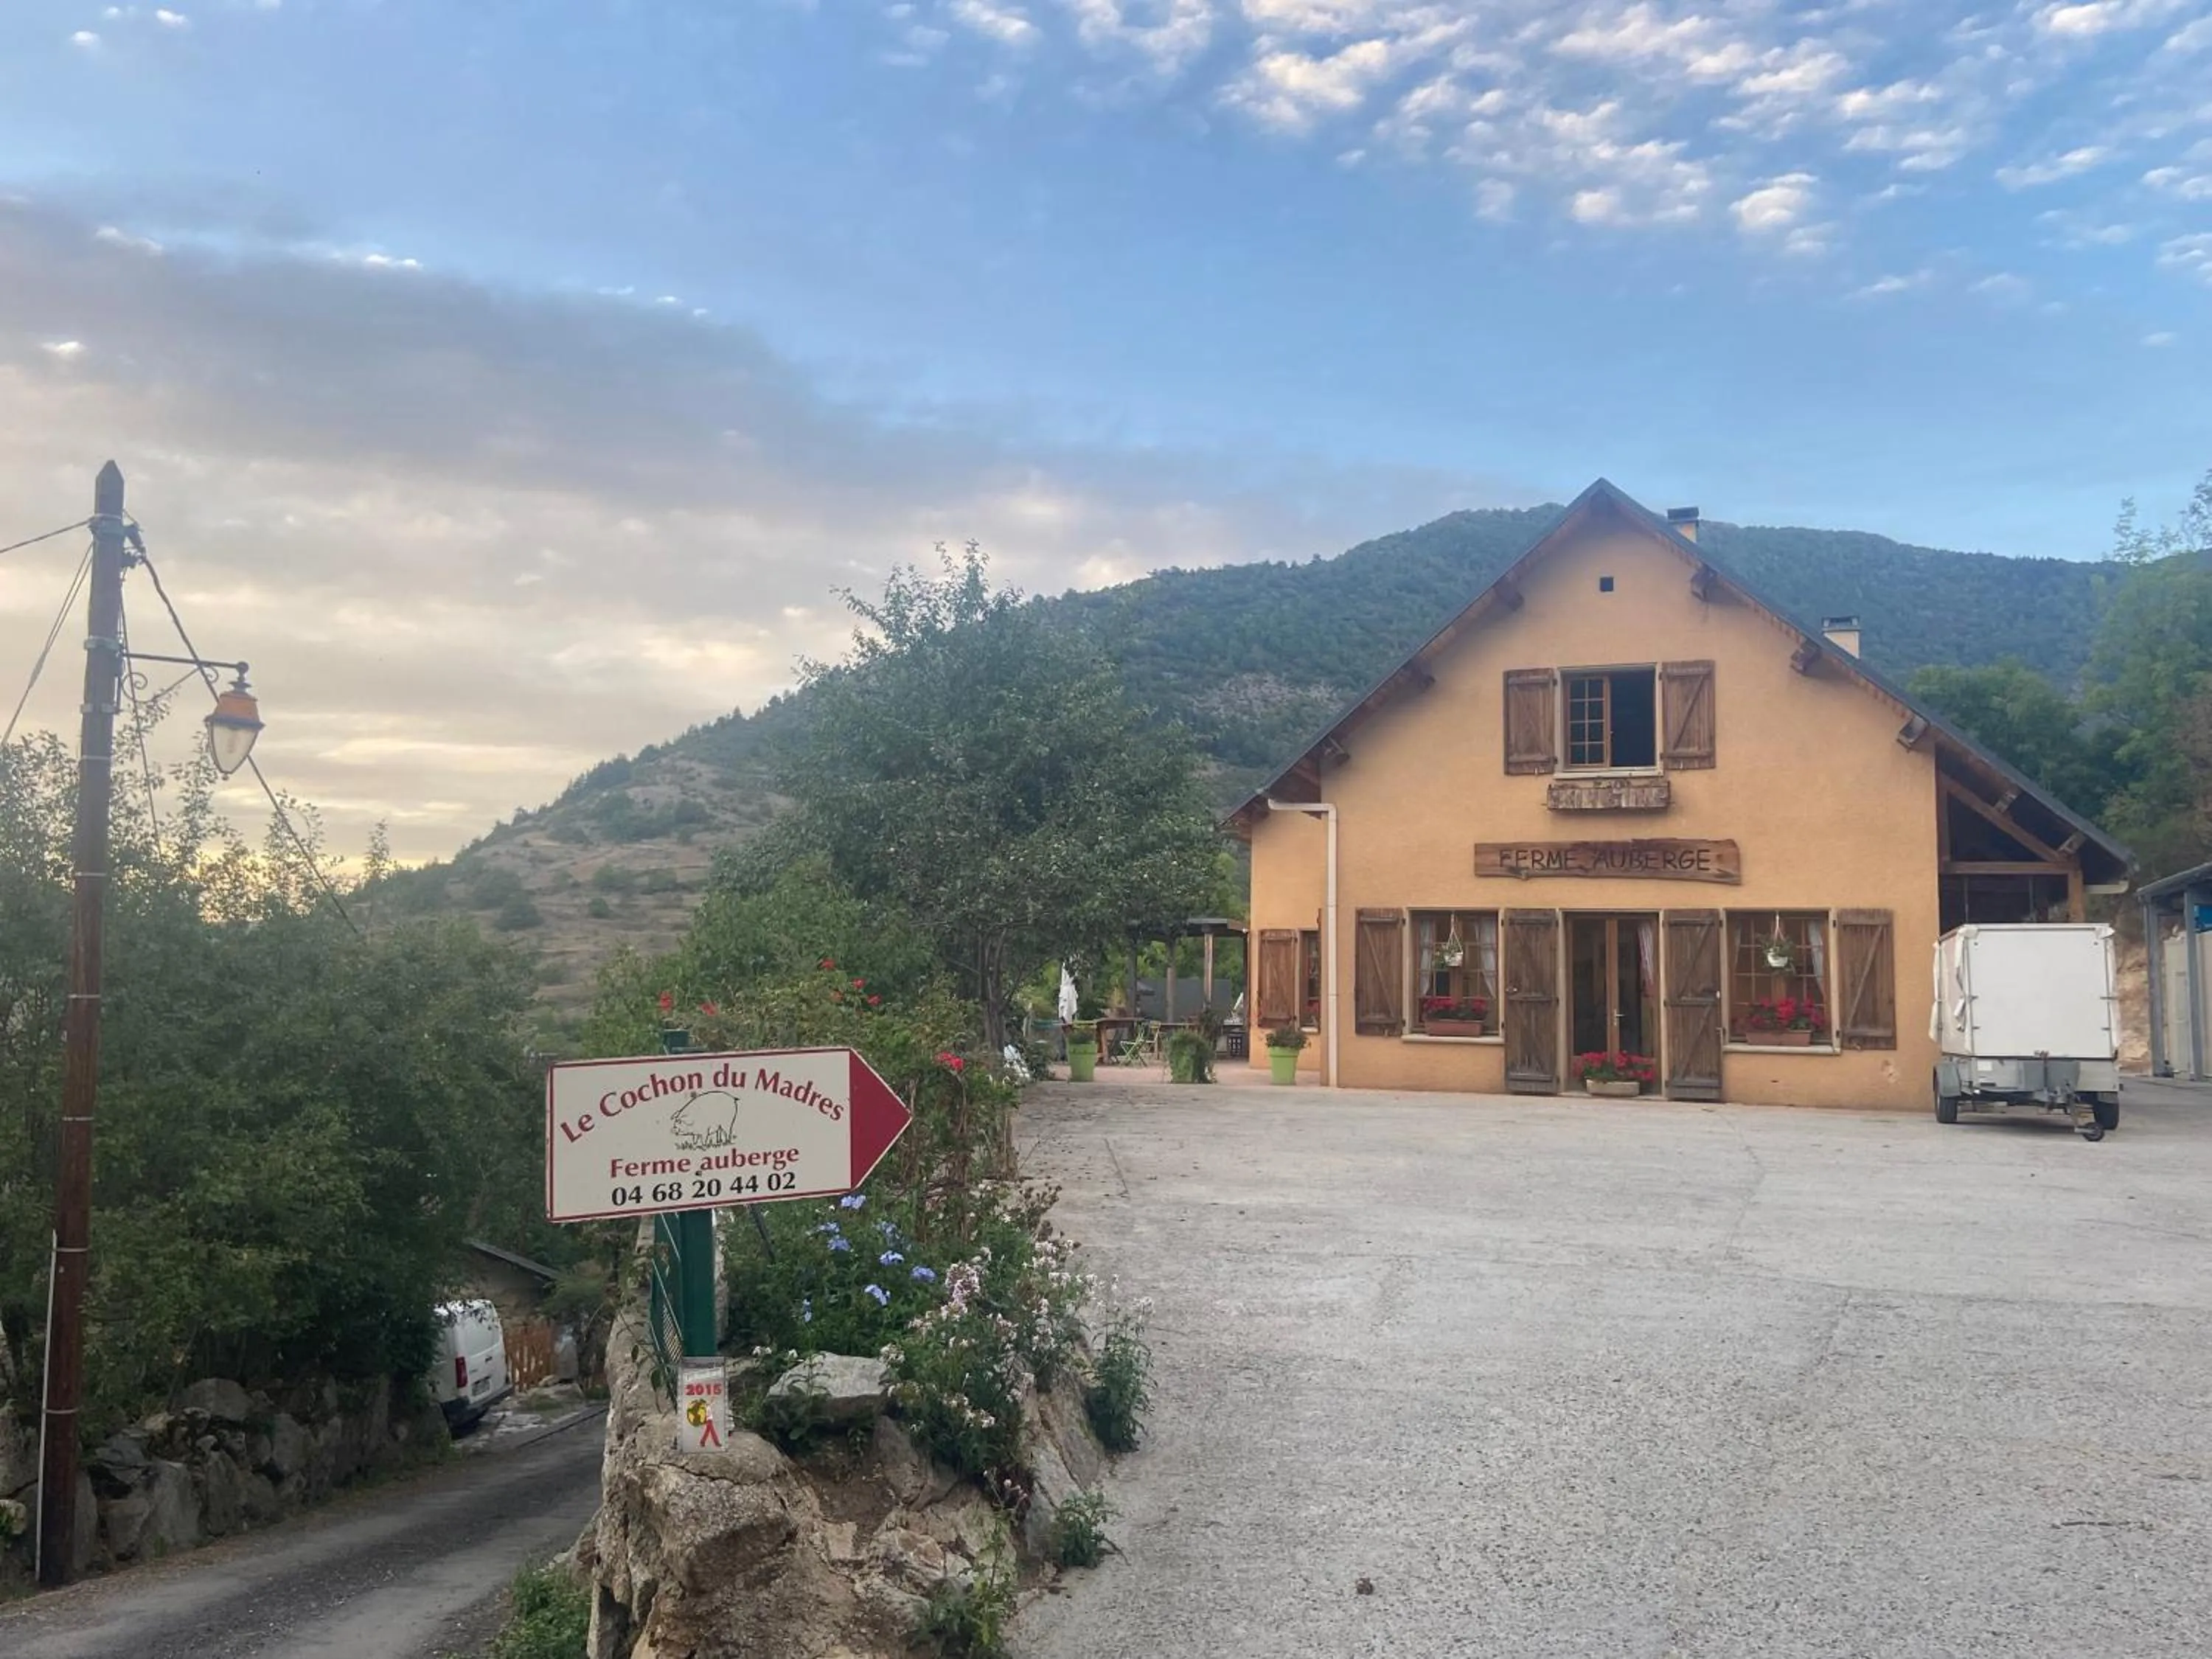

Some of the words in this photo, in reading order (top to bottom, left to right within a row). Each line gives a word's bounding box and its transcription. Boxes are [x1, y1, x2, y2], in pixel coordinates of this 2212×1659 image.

[1499, 849, 1579, 871] FERME
[1593, 849, 1711, 872] AUBERGE
[560, 1113, 594, 1143] Le
[599, 1071, 702, 1118] Cochon
[713, 1062, 745, 1088] du
[755, 1068, 844, 1121] Madres
[611, 1157, 691, 1178] Ferme
[700, 1148, 799, 1172] auberge
[611, 1186, 643, 1206] 04
[652, 1181, 683, 1202] 68
[692, 1178, 721, 1199] 20
[730, 1175, 759, 1194] 44
[768, 1171, 796, 1191] 02
[685, 1383, 722, 1396] 2015
